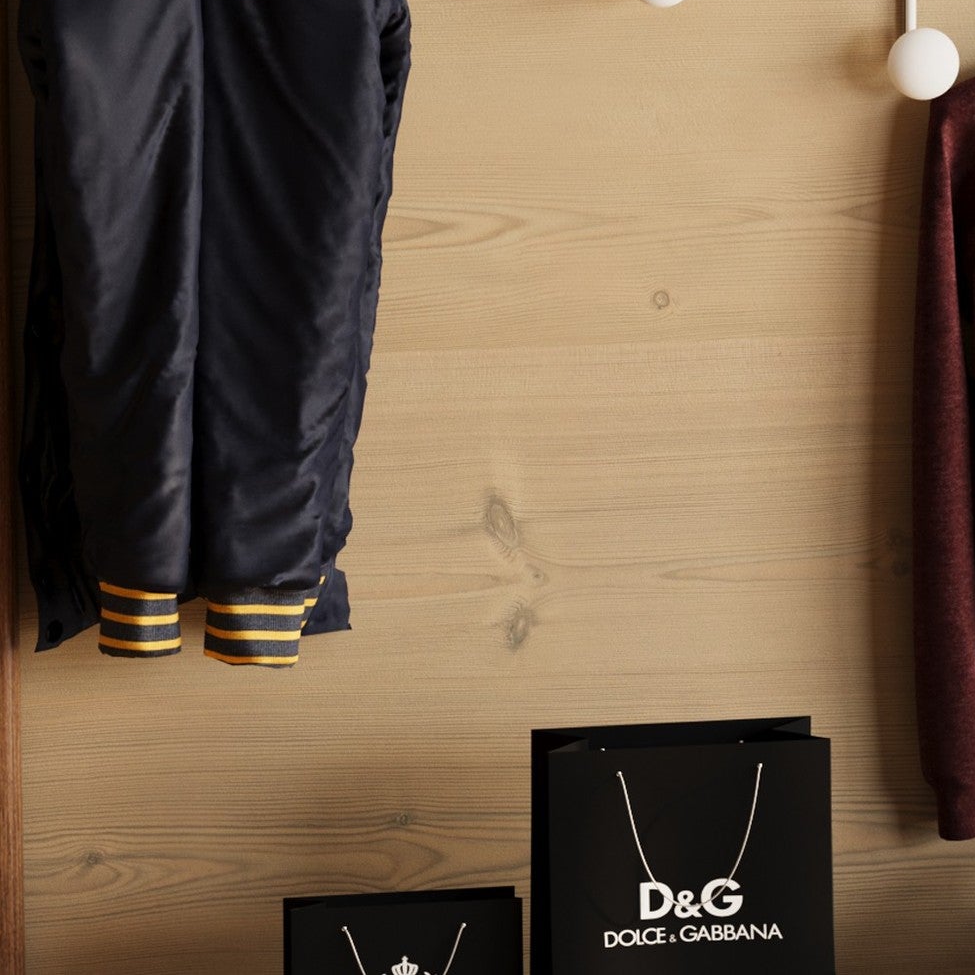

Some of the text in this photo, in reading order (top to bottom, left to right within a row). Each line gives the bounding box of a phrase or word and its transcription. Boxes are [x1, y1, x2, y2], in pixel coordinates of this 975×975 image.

[639, 878, 743, 921] D&G
[604, 923, 783, 948] DOLCE & GABBANA
